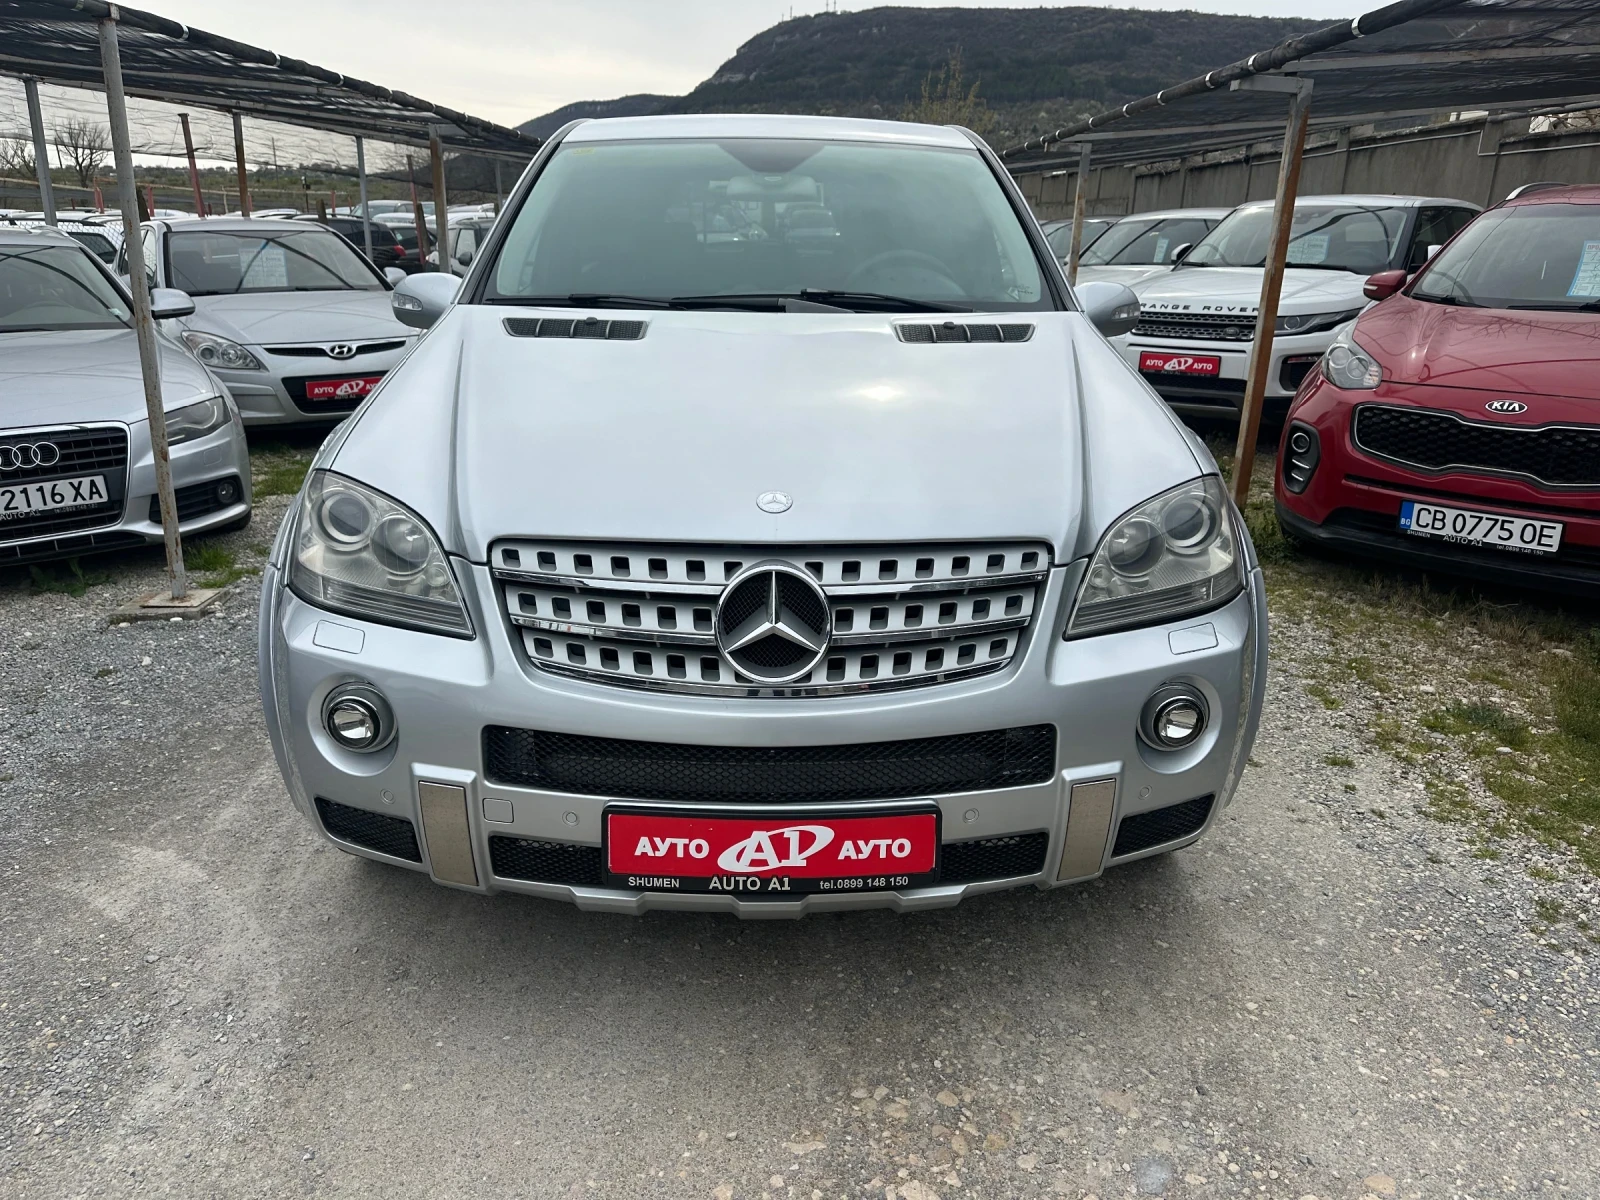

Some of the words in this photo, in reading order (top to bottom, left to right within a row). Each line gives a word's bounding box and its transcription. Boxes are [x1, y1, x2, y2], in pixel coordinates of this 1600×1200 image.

[1140, 302, 1191, 310] RANGE
[1145, 359, 1164, 367] АУТО
[1192, 362, 1213, 370] АУТО
[1491, 401, 1520, 411] KIA
[0, 483, 65, 511] 2116
[68, 479, 103, 502] XA
[1400, 517, 1411, 526] BG
[1415, 507, 1447, 531] CB
[1452, 513, 1515, 541] 0775
[1519, 522, 1557, 548] OE
[1407, 529, 1431, 538] SHUMEN
[1443, 534, 1468, 544] AUTO
[1471, 538, 1483, 547] A1
[634, 836, 710, 859] АУТО
[837, 838, 912, 860] АУТО
[628, 876, 680, 888] SHUMEN
[708, 876, 761, 891] AUTO
[768, 877, 791, 891] A1
[820, 878, 863, 890] tel.0899
[866, 877, 886, 888] 148
[889, 876, 909, 886] 150
